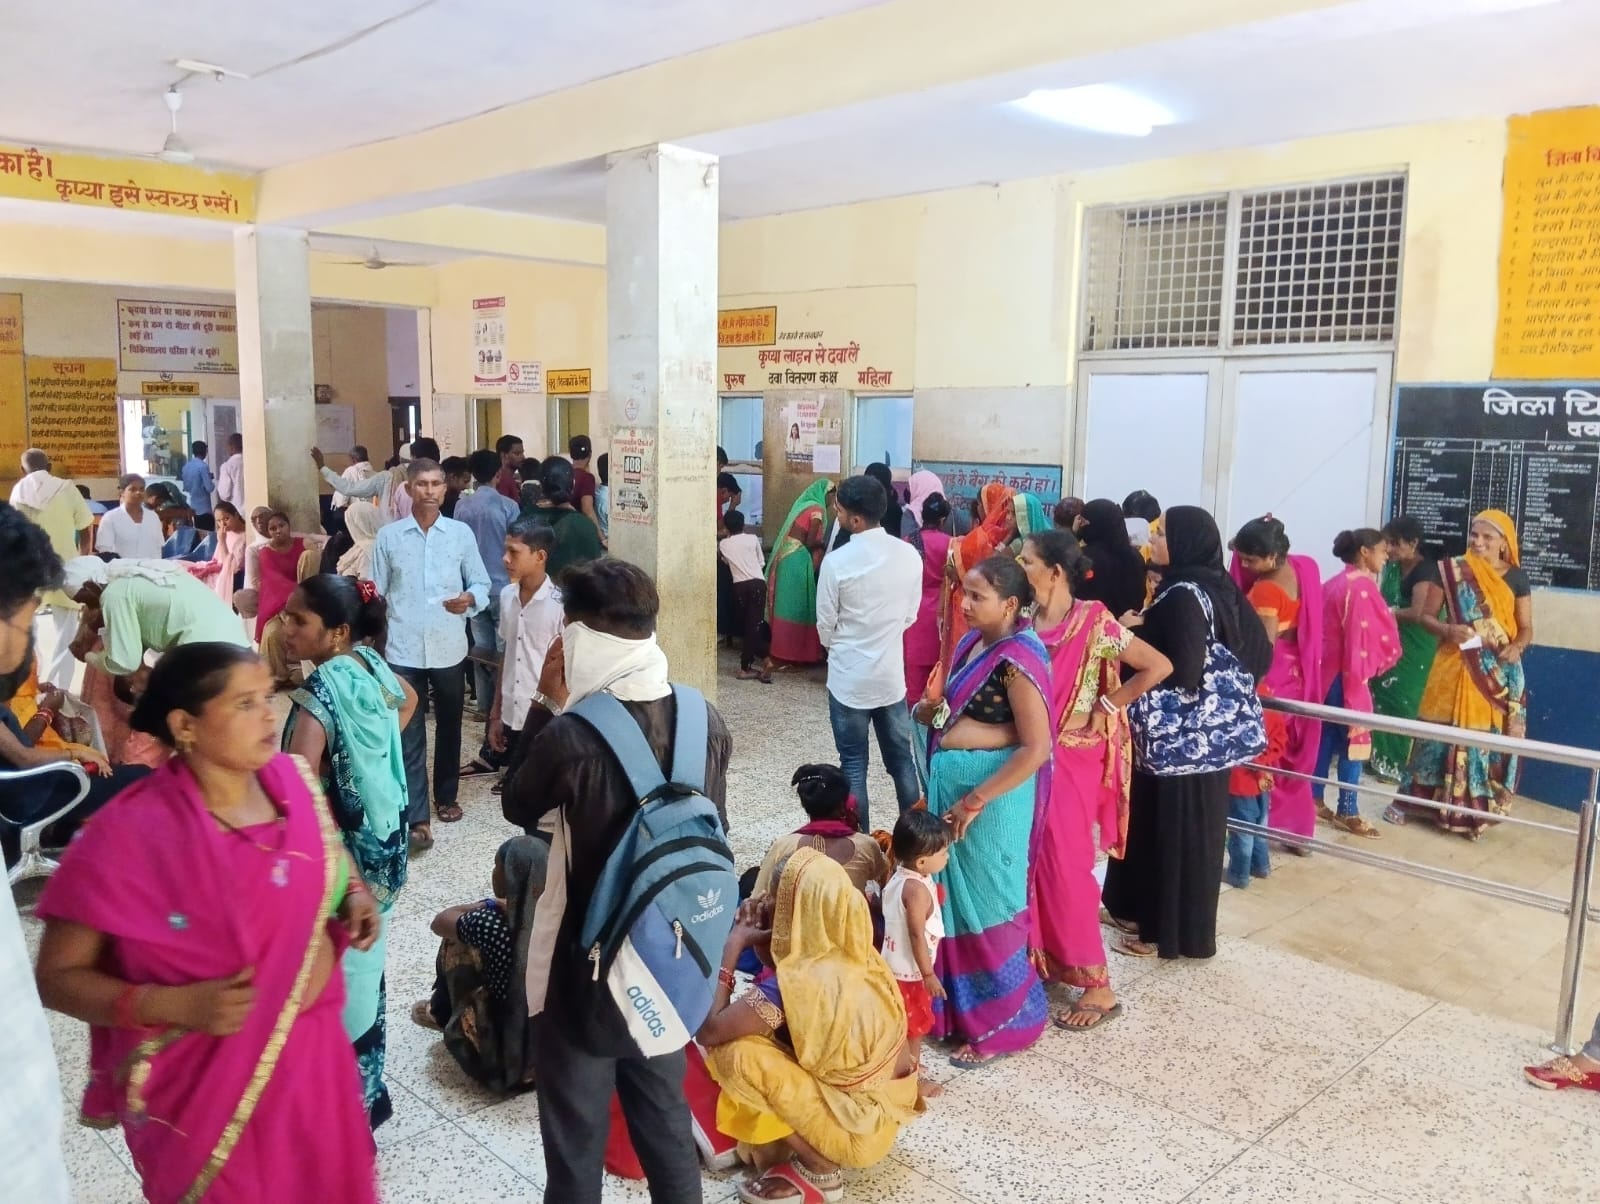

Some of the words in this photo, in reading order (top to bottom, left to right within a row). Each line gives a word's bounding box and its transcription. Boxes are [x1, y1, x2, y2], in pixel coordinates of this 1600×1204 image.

[783, 348, 811, 367] लाइन
[814, 342, 827, 364] से
[53, 362, 85, 376] सूचना
[768, 371, 782, 385] दवा
[785, 368, 816, 386] वितरण
[819, 370, 839, 386] कक्ष
[857, 366, 893, 388] महिला
[724, 372, 746, 390] पुरुष
[1483, 388, 1556, 416] जिला
[625, 456, 641, 474] 108
[691, 904, 725, 924] adidas
[626, 985, 667, 1038] adidas
